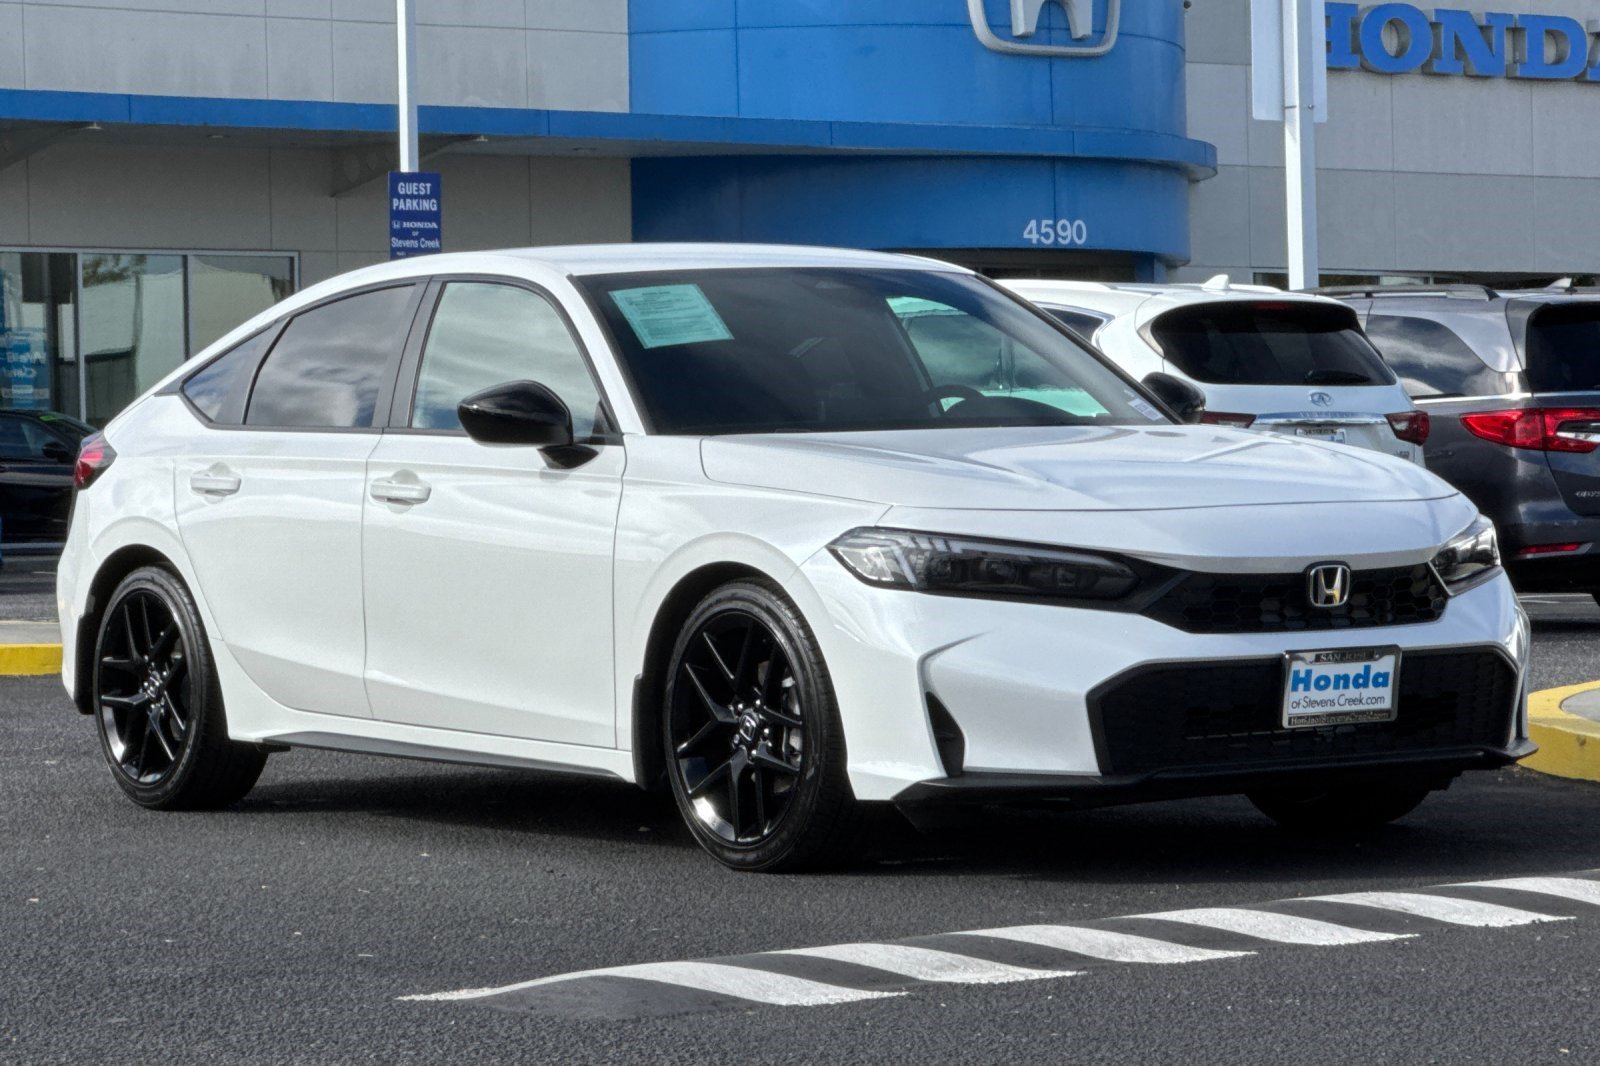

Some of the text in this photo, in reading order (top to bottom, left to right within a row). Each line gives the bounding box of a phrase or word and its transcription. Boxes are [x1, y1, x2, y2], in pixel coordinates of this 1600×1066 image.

[1325, 2, 1600, 81] OND
[398, 182, 432, 195] GUEST
[393, 198, 438, 211] PARKING
[402, 221, 438, 229] HONDA
[1023, 219, 1087, 244] 4590
[391, 236, 440, 248] Stevens Creek
[1320, 652, 1341, 662] SAN
[1291, 664, 1390, 692] Honda
[1291, 691, 1386, 709] of Stevens Creek.com
